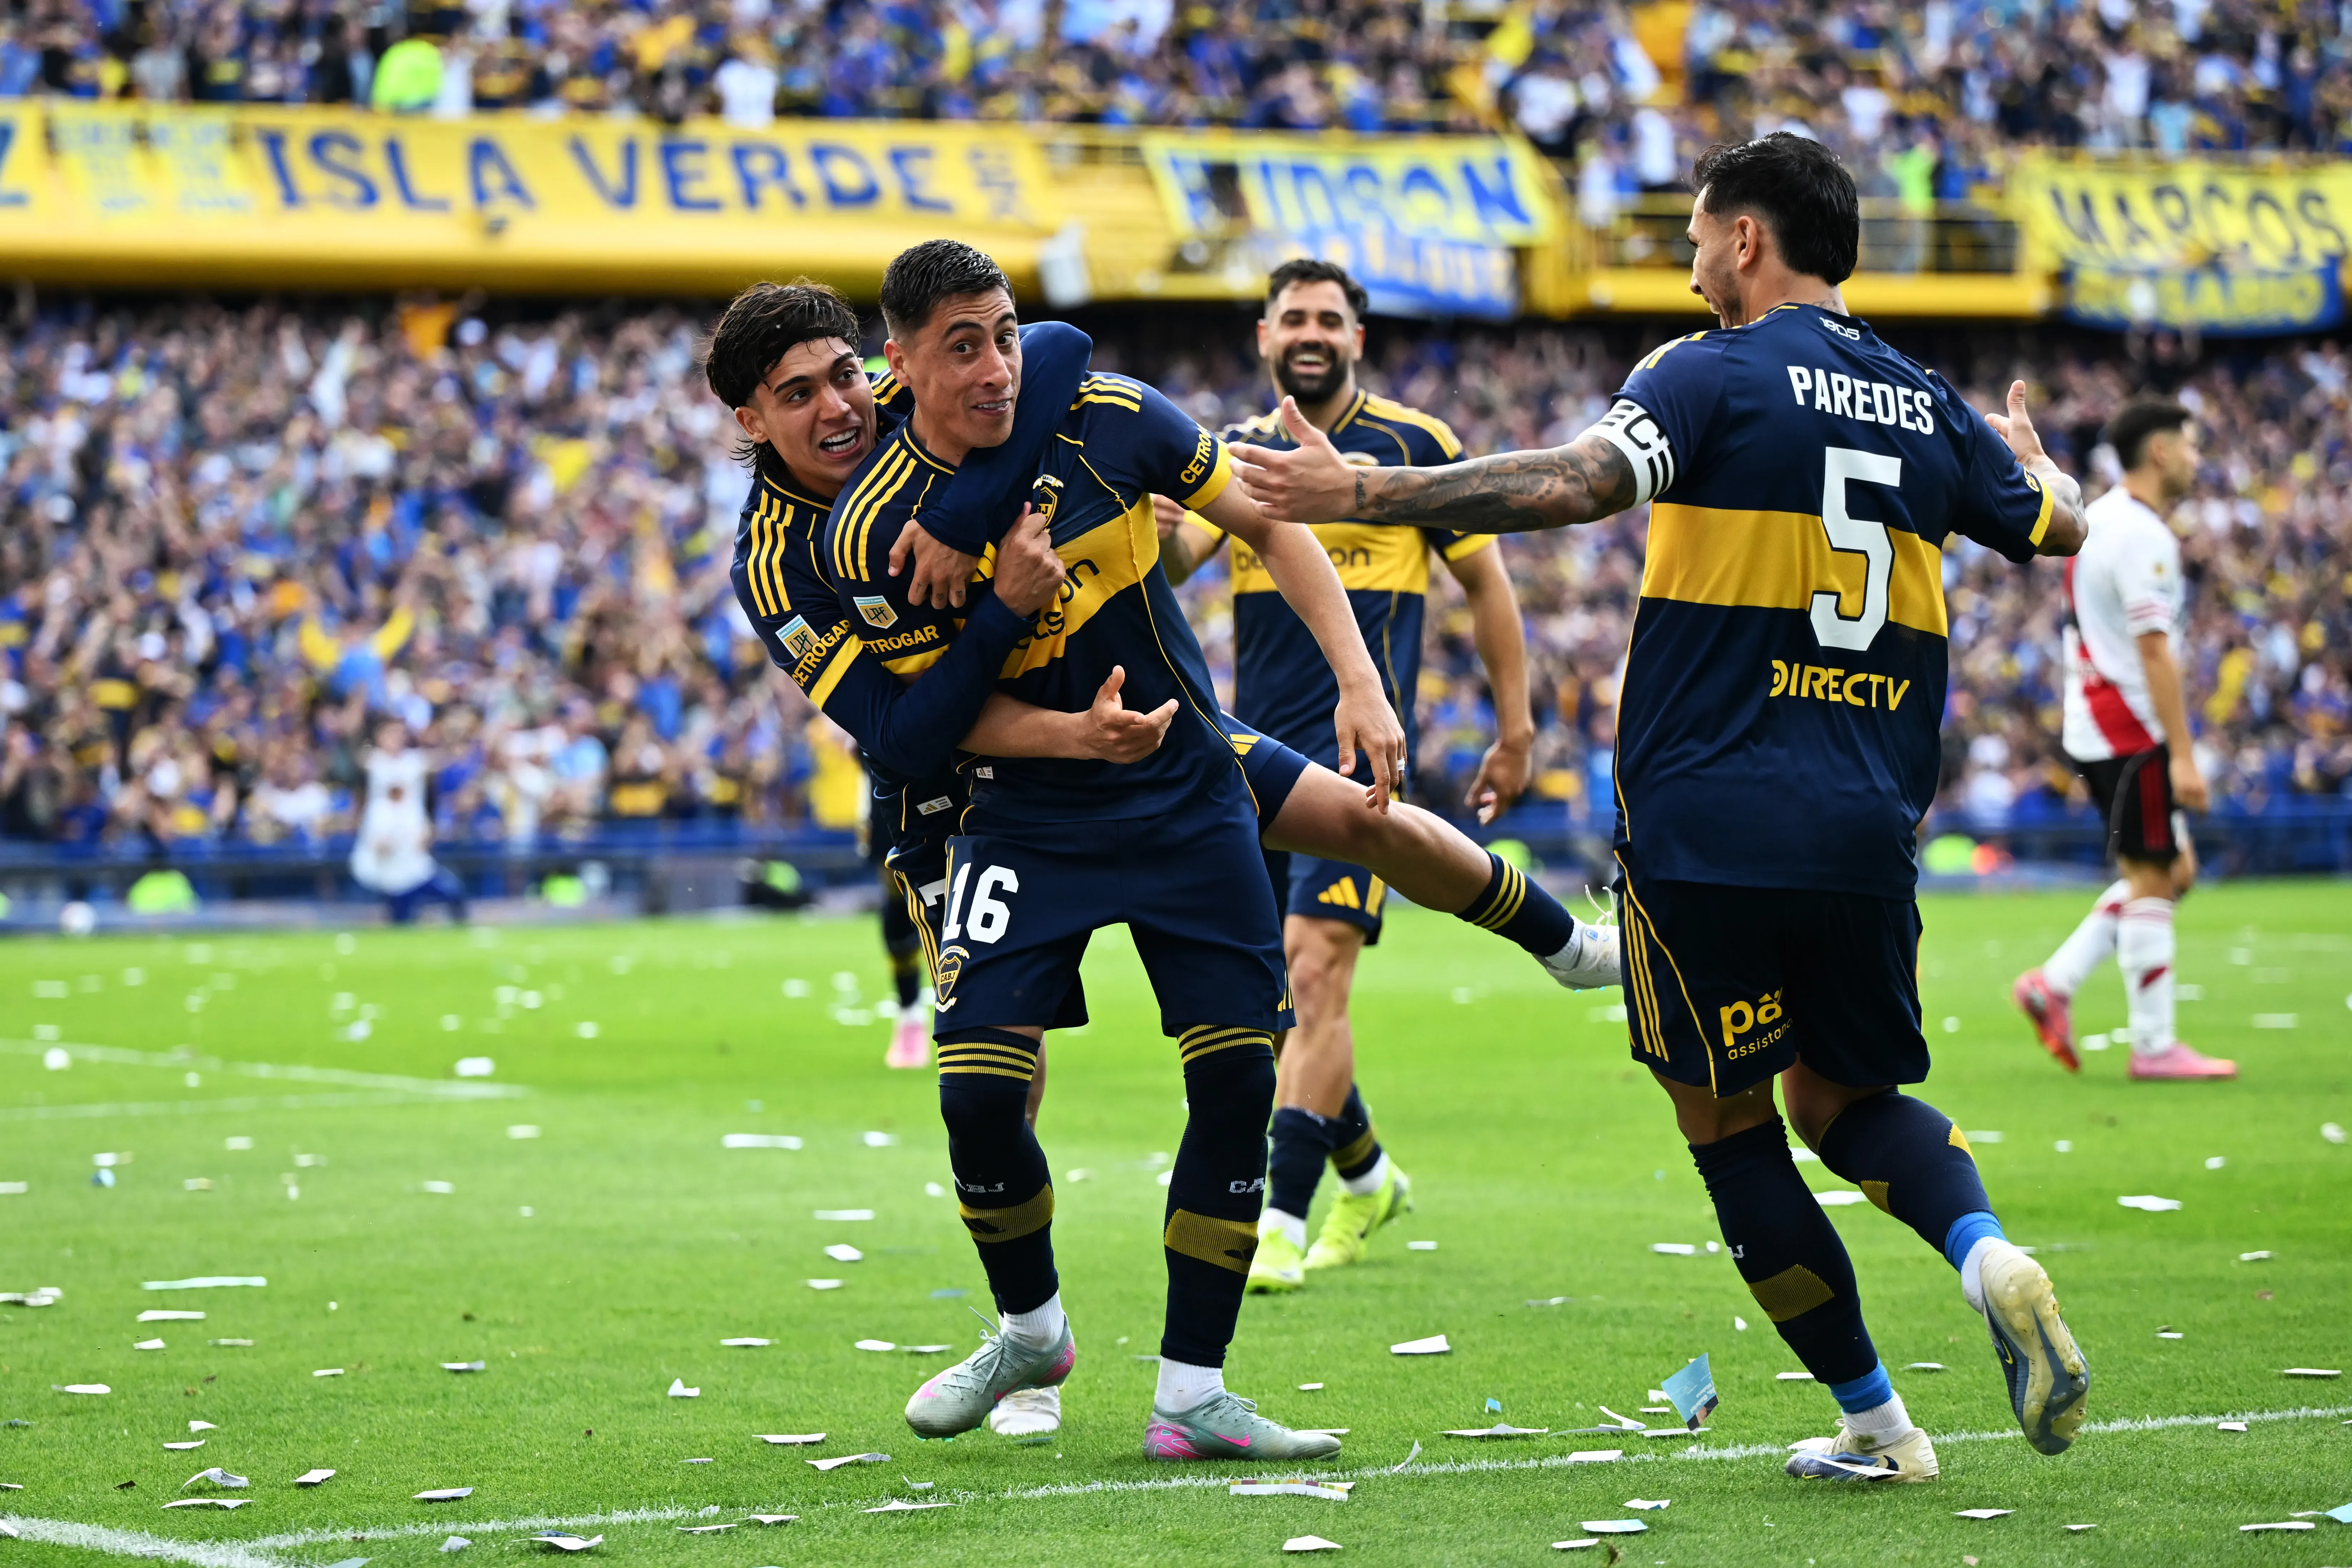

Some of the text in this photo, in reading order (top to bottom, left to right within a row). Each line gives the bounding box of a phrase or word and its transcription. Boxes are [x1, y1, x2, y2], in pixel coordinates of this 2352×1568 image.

[256, 129, 537, 209] ISLA
[569, 134, 955, 212] VERDE
[1819, 317, 1860, 340] 1905
[1787, 366, 1934, 435] PAREDES
[1810, 446, 1902, 651] 5
[1769, 660, 1910, 710] DIRECTV
[943, 863, 1019, 944] 16
[941, 972, 956, 982] CABJ
